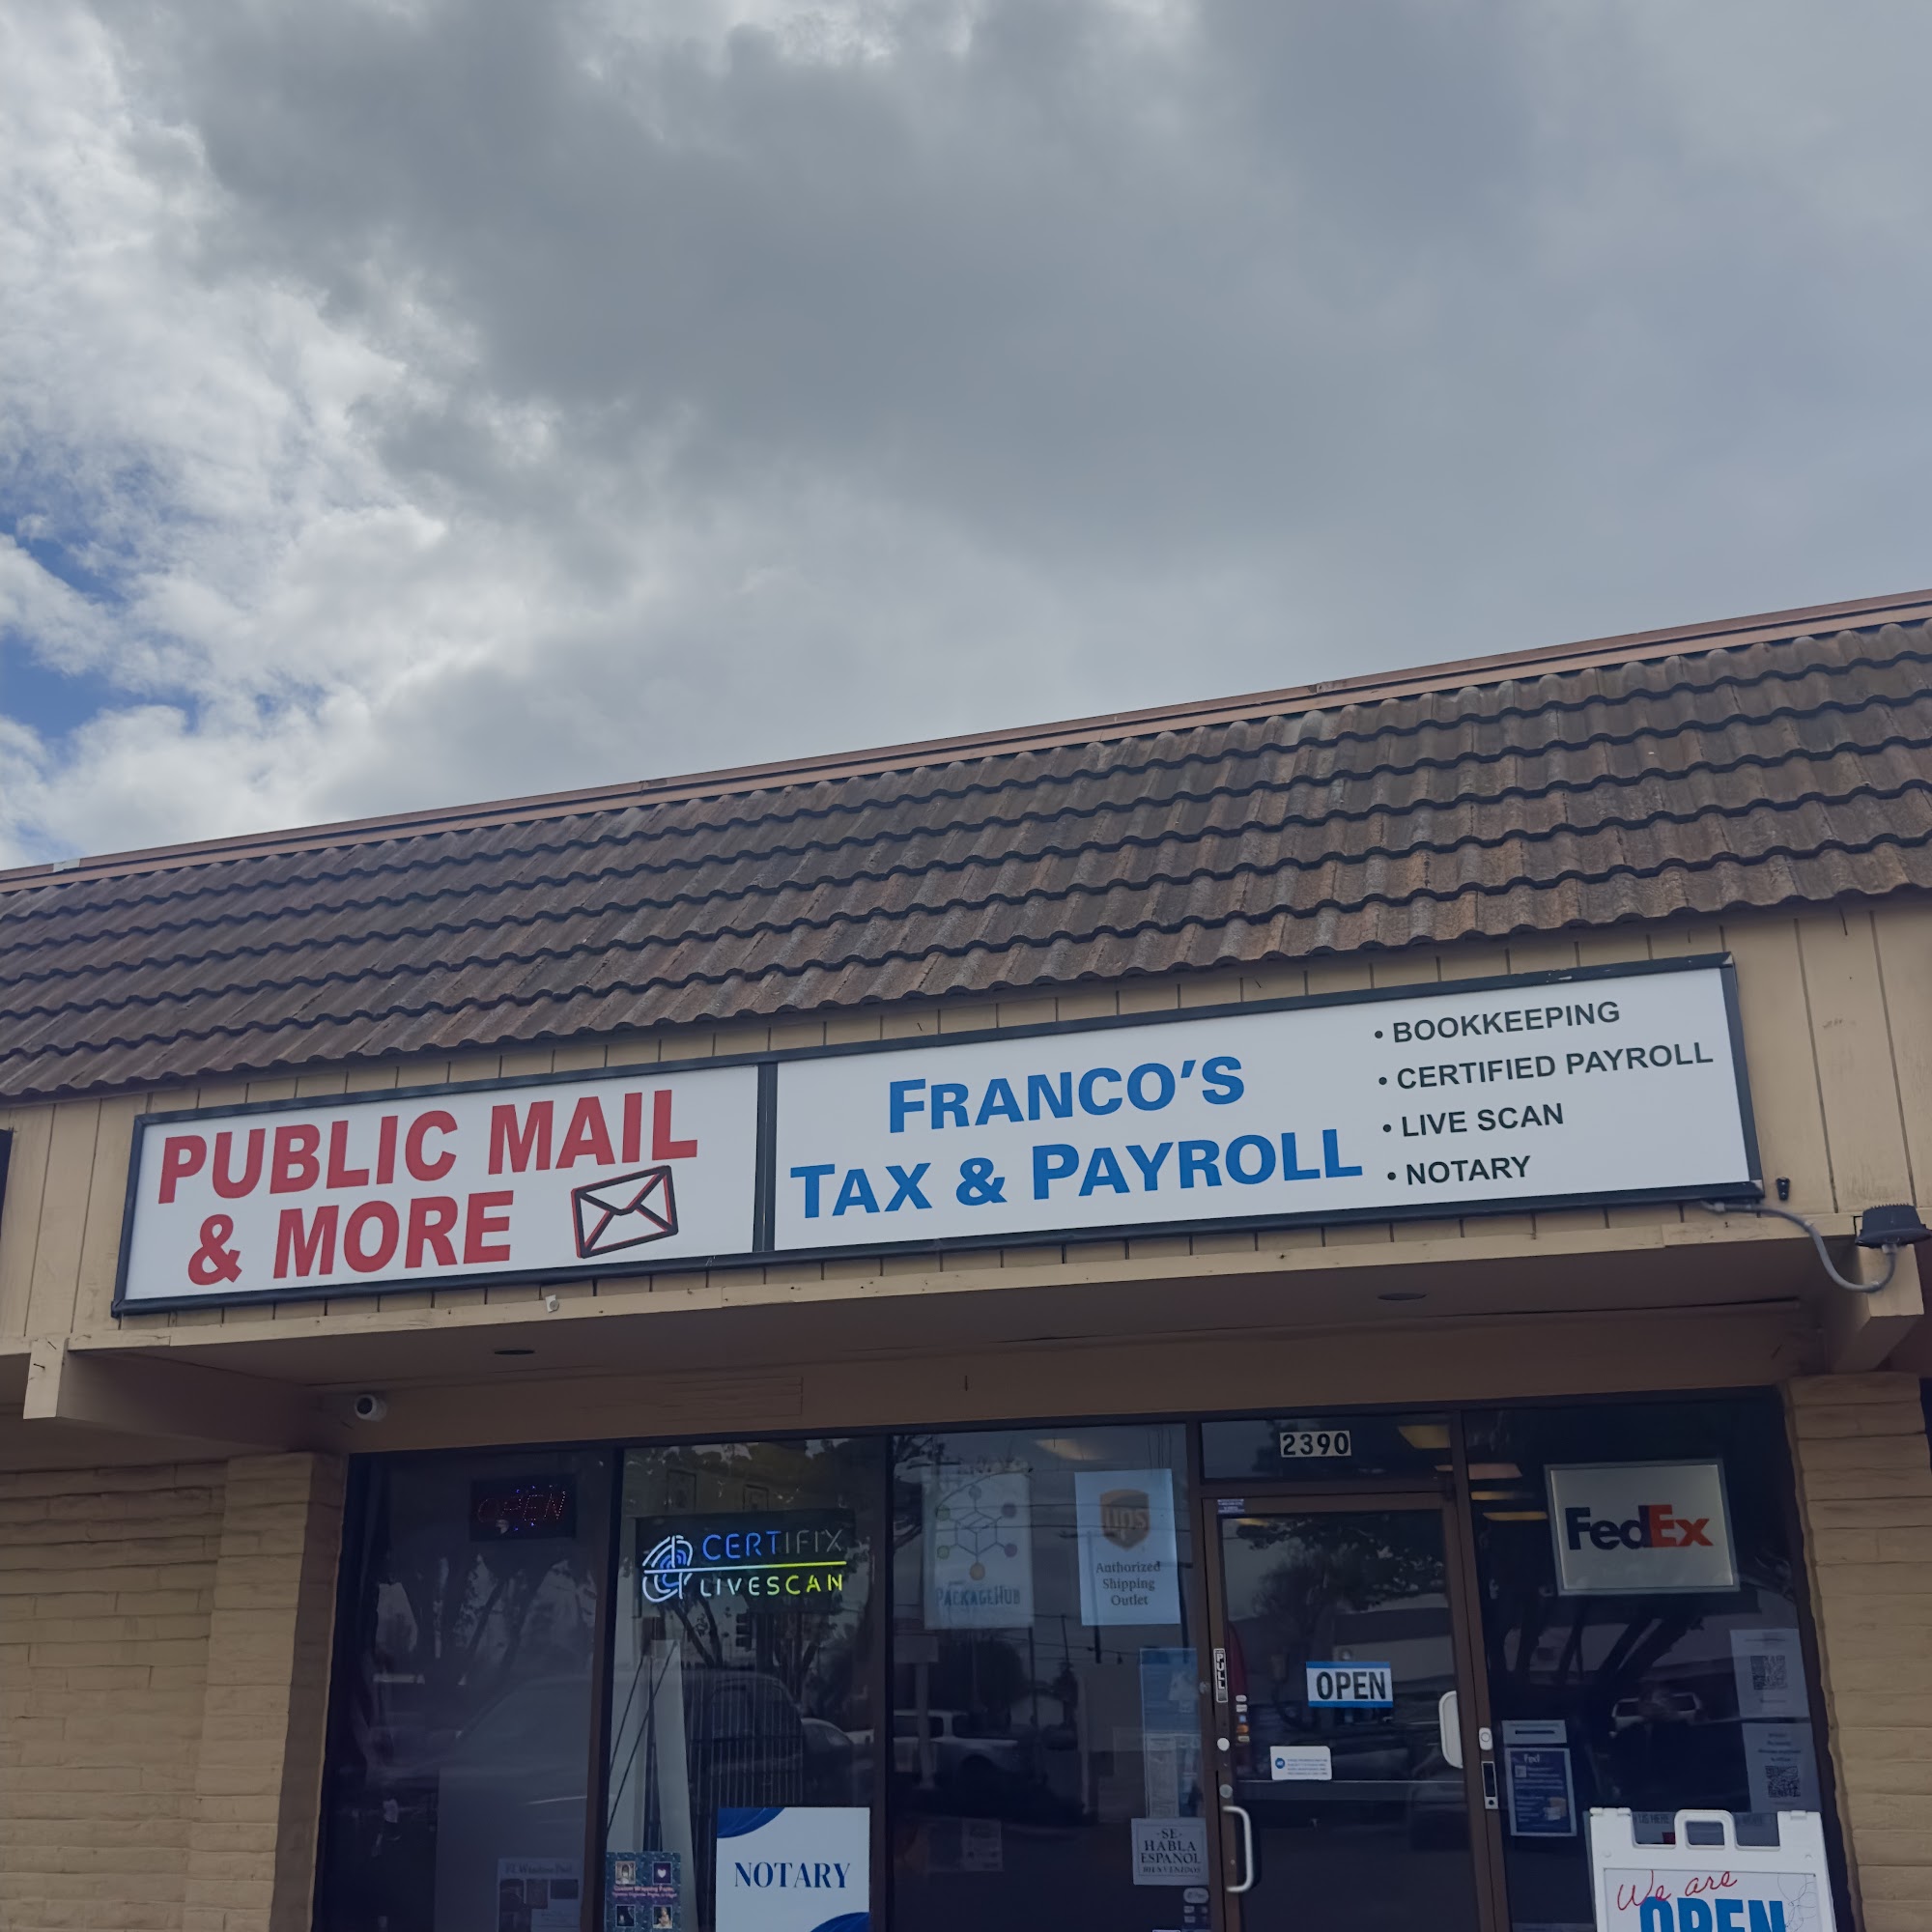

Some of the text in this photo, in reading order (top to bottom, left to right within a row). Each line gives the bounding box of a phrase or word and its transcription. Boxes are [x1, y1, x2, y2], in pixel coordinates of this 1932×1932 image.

[1393, 1001, 1620, 1043] BOOKKEEPING
[1397, 1041, 1714, 1090] CERTIFIED PAYROLL
[1402, 1103, 1564, 1137] LIVE SCAN
[157, 1089, 698, 1205] PUBLIC MAIL
[790, 1128, 1363, 1219] TAX & PAYROLL
[1406, 1155, 1531, 1185] NOTARY
[187, 1189, 514, 1287] & MORE
[1283, 1432, 1350, 1456] 2390
[477, 1484, 566, 1523] OPEN
[1565, 1504, 1715, 1550] FedEx
[702, 1528, 842, 1561] CERTIFIX
[1095, 1560, 1160, 1575] Authorized
[699, 1573, 843, 1598] LIVESCAN
[1102, 1577, 1155, 1592] Shipping
[1110, 1595, 1150, 1607] Outlet
[1216, 1653, 1226, 1690] PULL
[1316, 1670, 1386, 1700] OPEN
[1144, 1839, 1197, 1852] HABLA
[1161, 1829, 1178, 1839] SE
[734, 1861, 851, 1889] NOTARY
[1617, 1869, 1738, 1911] We are
